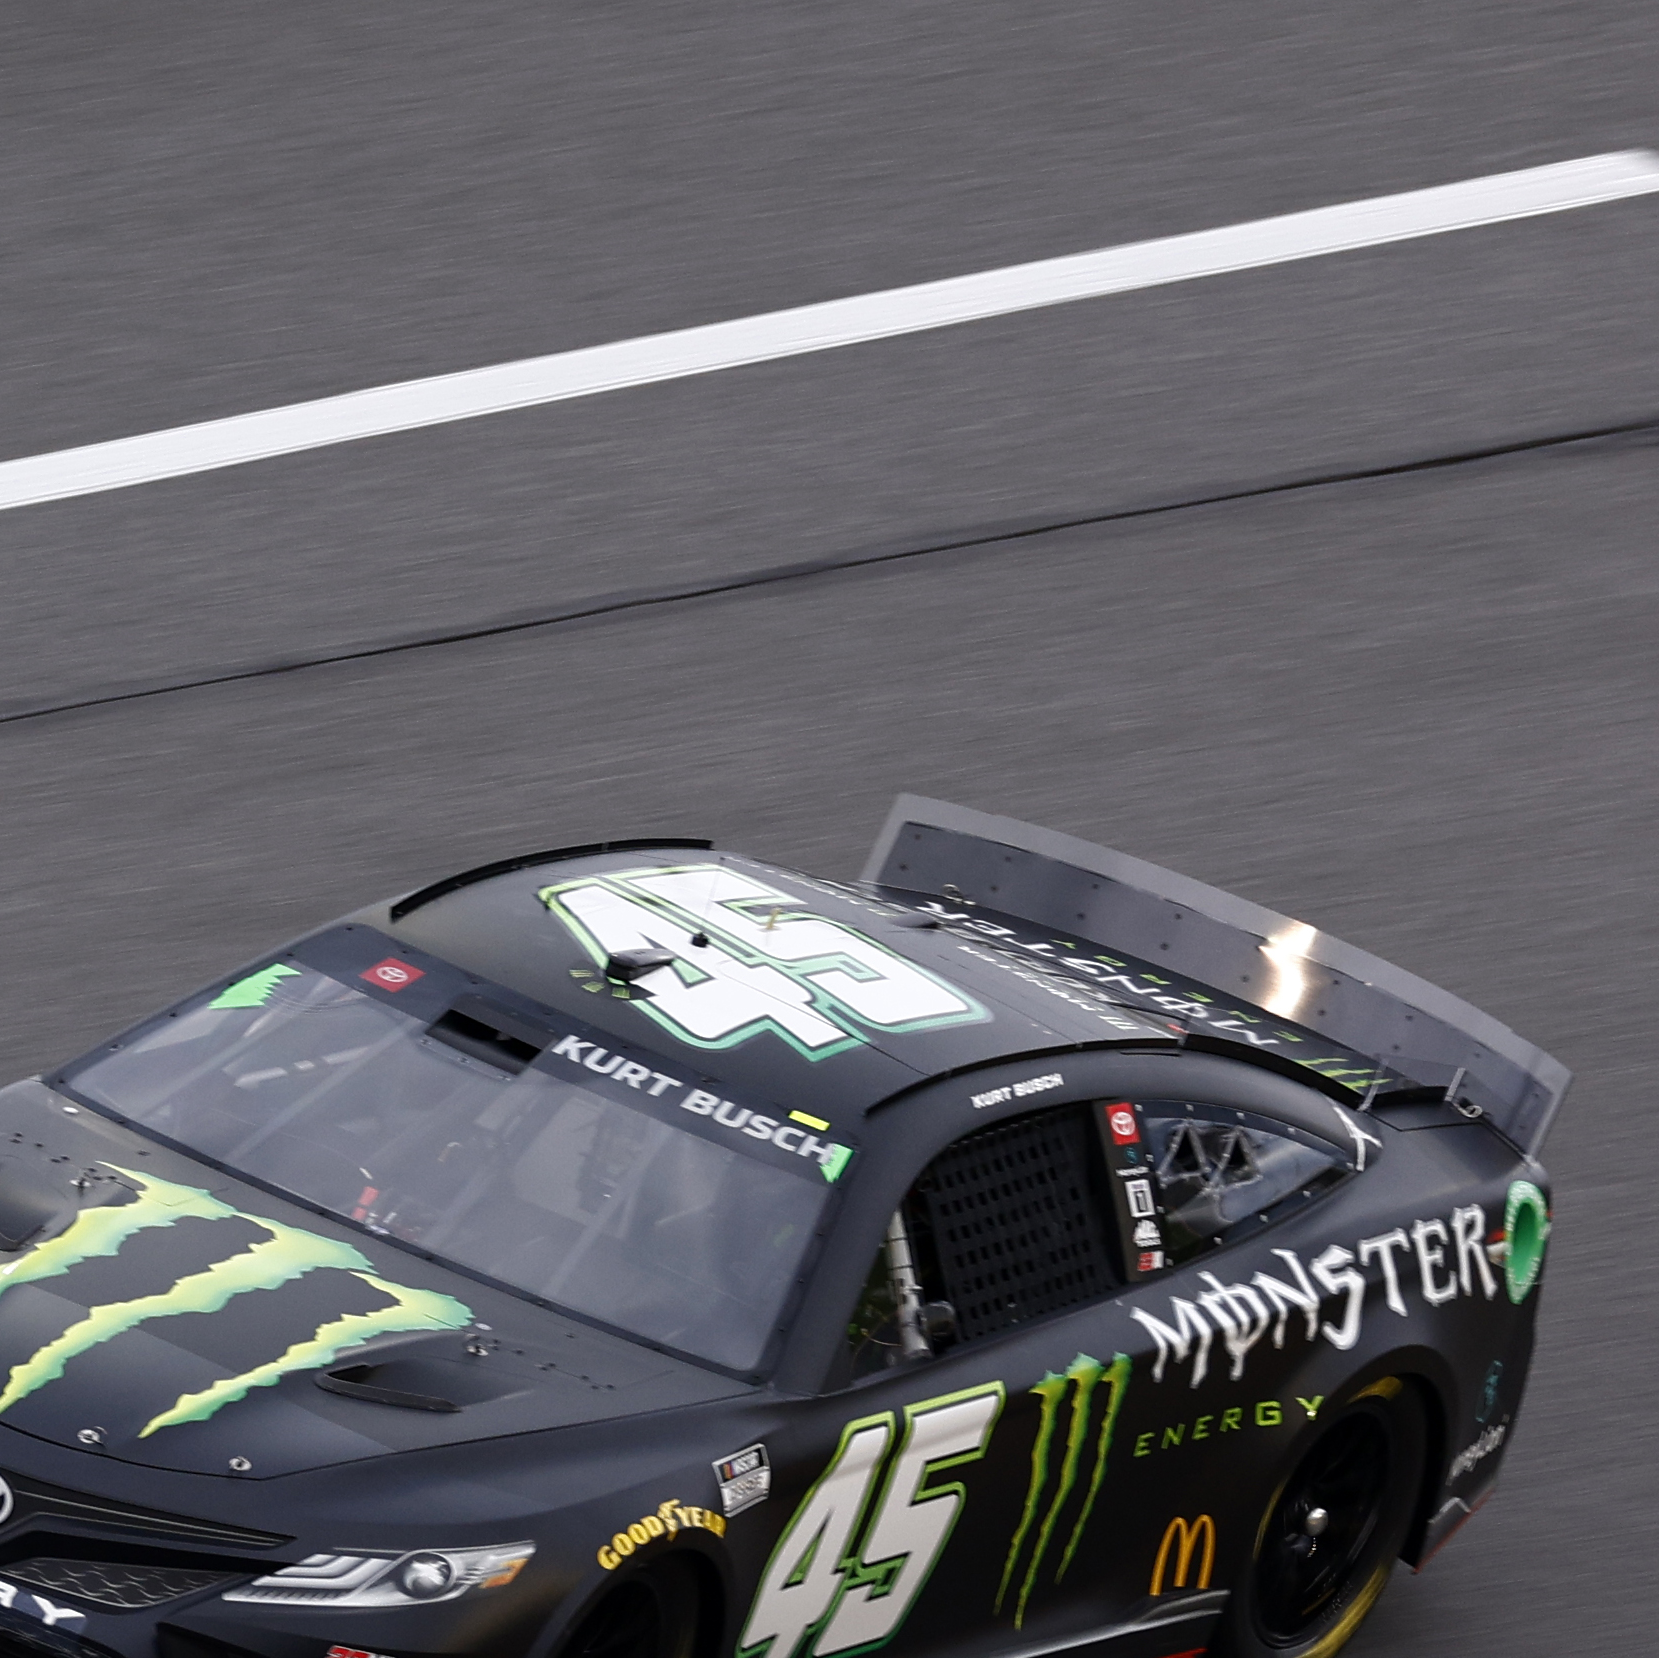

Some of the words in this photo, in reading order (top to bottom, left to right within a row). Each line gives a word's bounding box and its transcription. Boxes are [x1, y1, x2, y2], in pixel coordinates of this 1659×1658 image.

[538, 862, 992, 1061] 45
[552, 1034, 682, 1099] KURT
[682, 1087, 837, 1165] BUSCH
[969, 1086, 1013, 1109] KURT
[1012, 1072, 1064, 1098] BUSCH
[1130, 1203, 1499, 1388] MONSTER
[1133, 1394, 1324, 1457] ENERGY
[596, 1498, 727, 1571] GOODYEAR
